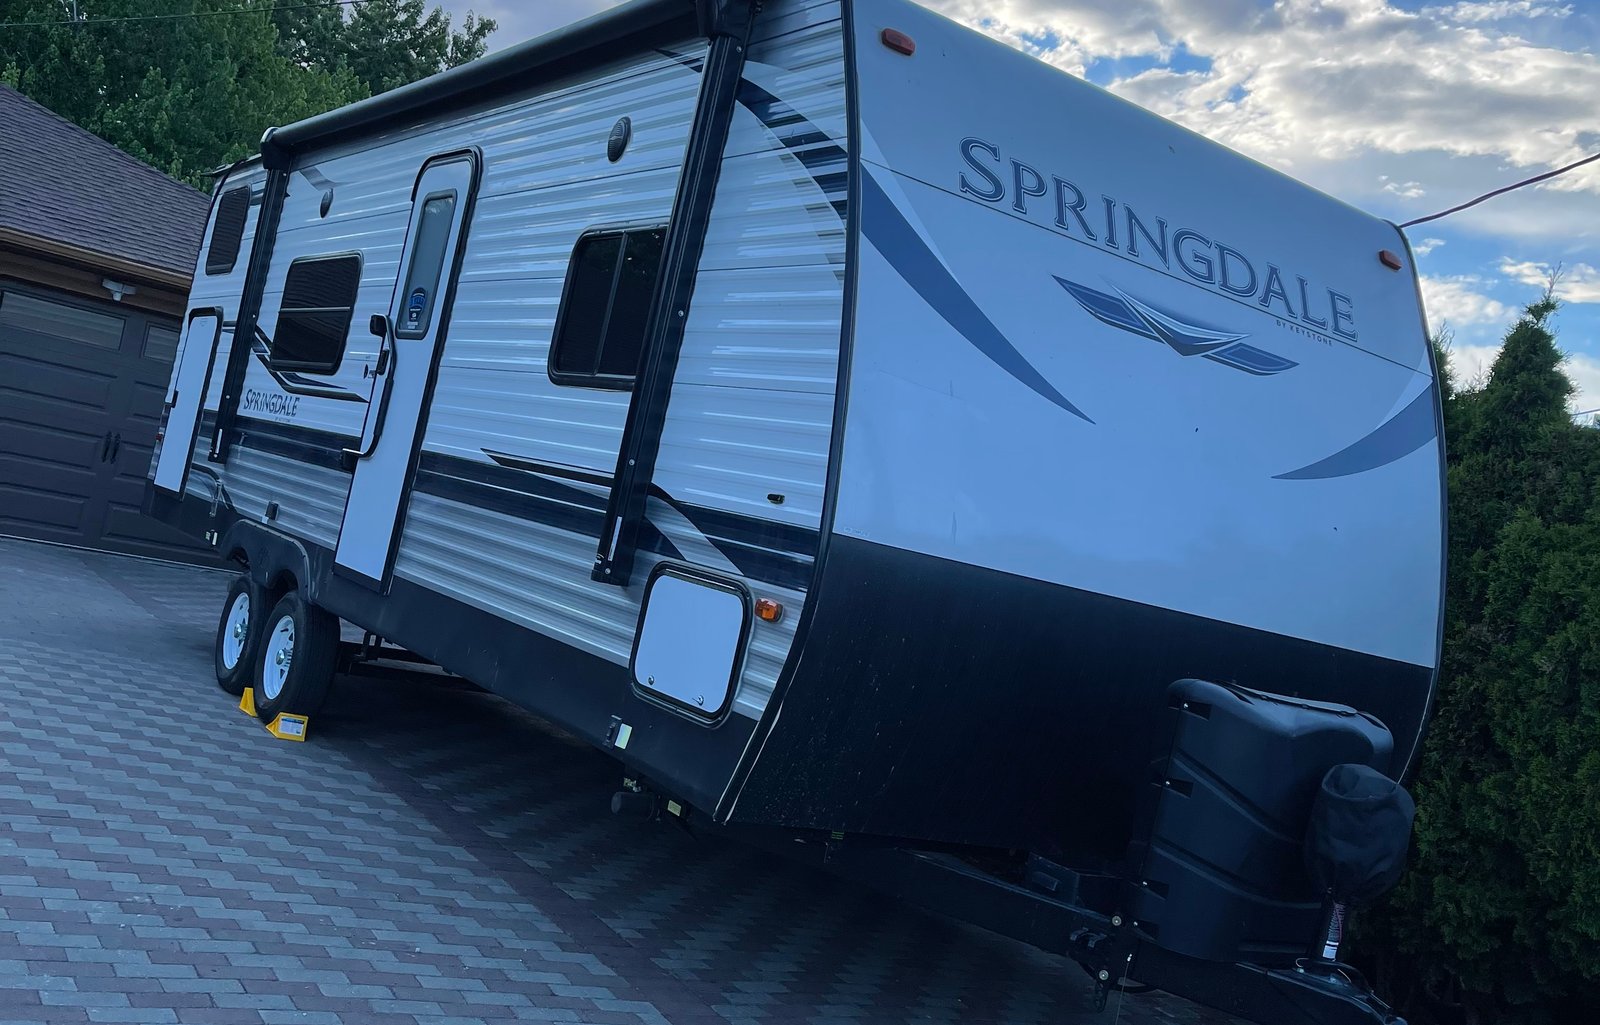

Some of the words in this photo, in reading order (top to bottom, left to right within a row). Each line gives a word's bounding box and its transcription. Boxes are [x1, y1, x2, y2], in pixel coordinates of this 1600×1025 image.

[959, 137, 1358, 342] SPRINGDALE
[1276, 320, 1287, 329] BY
[1290, 325, 1332, 346] KEYSTONE
[243, 389, 300, 417] SPRINGDALE
